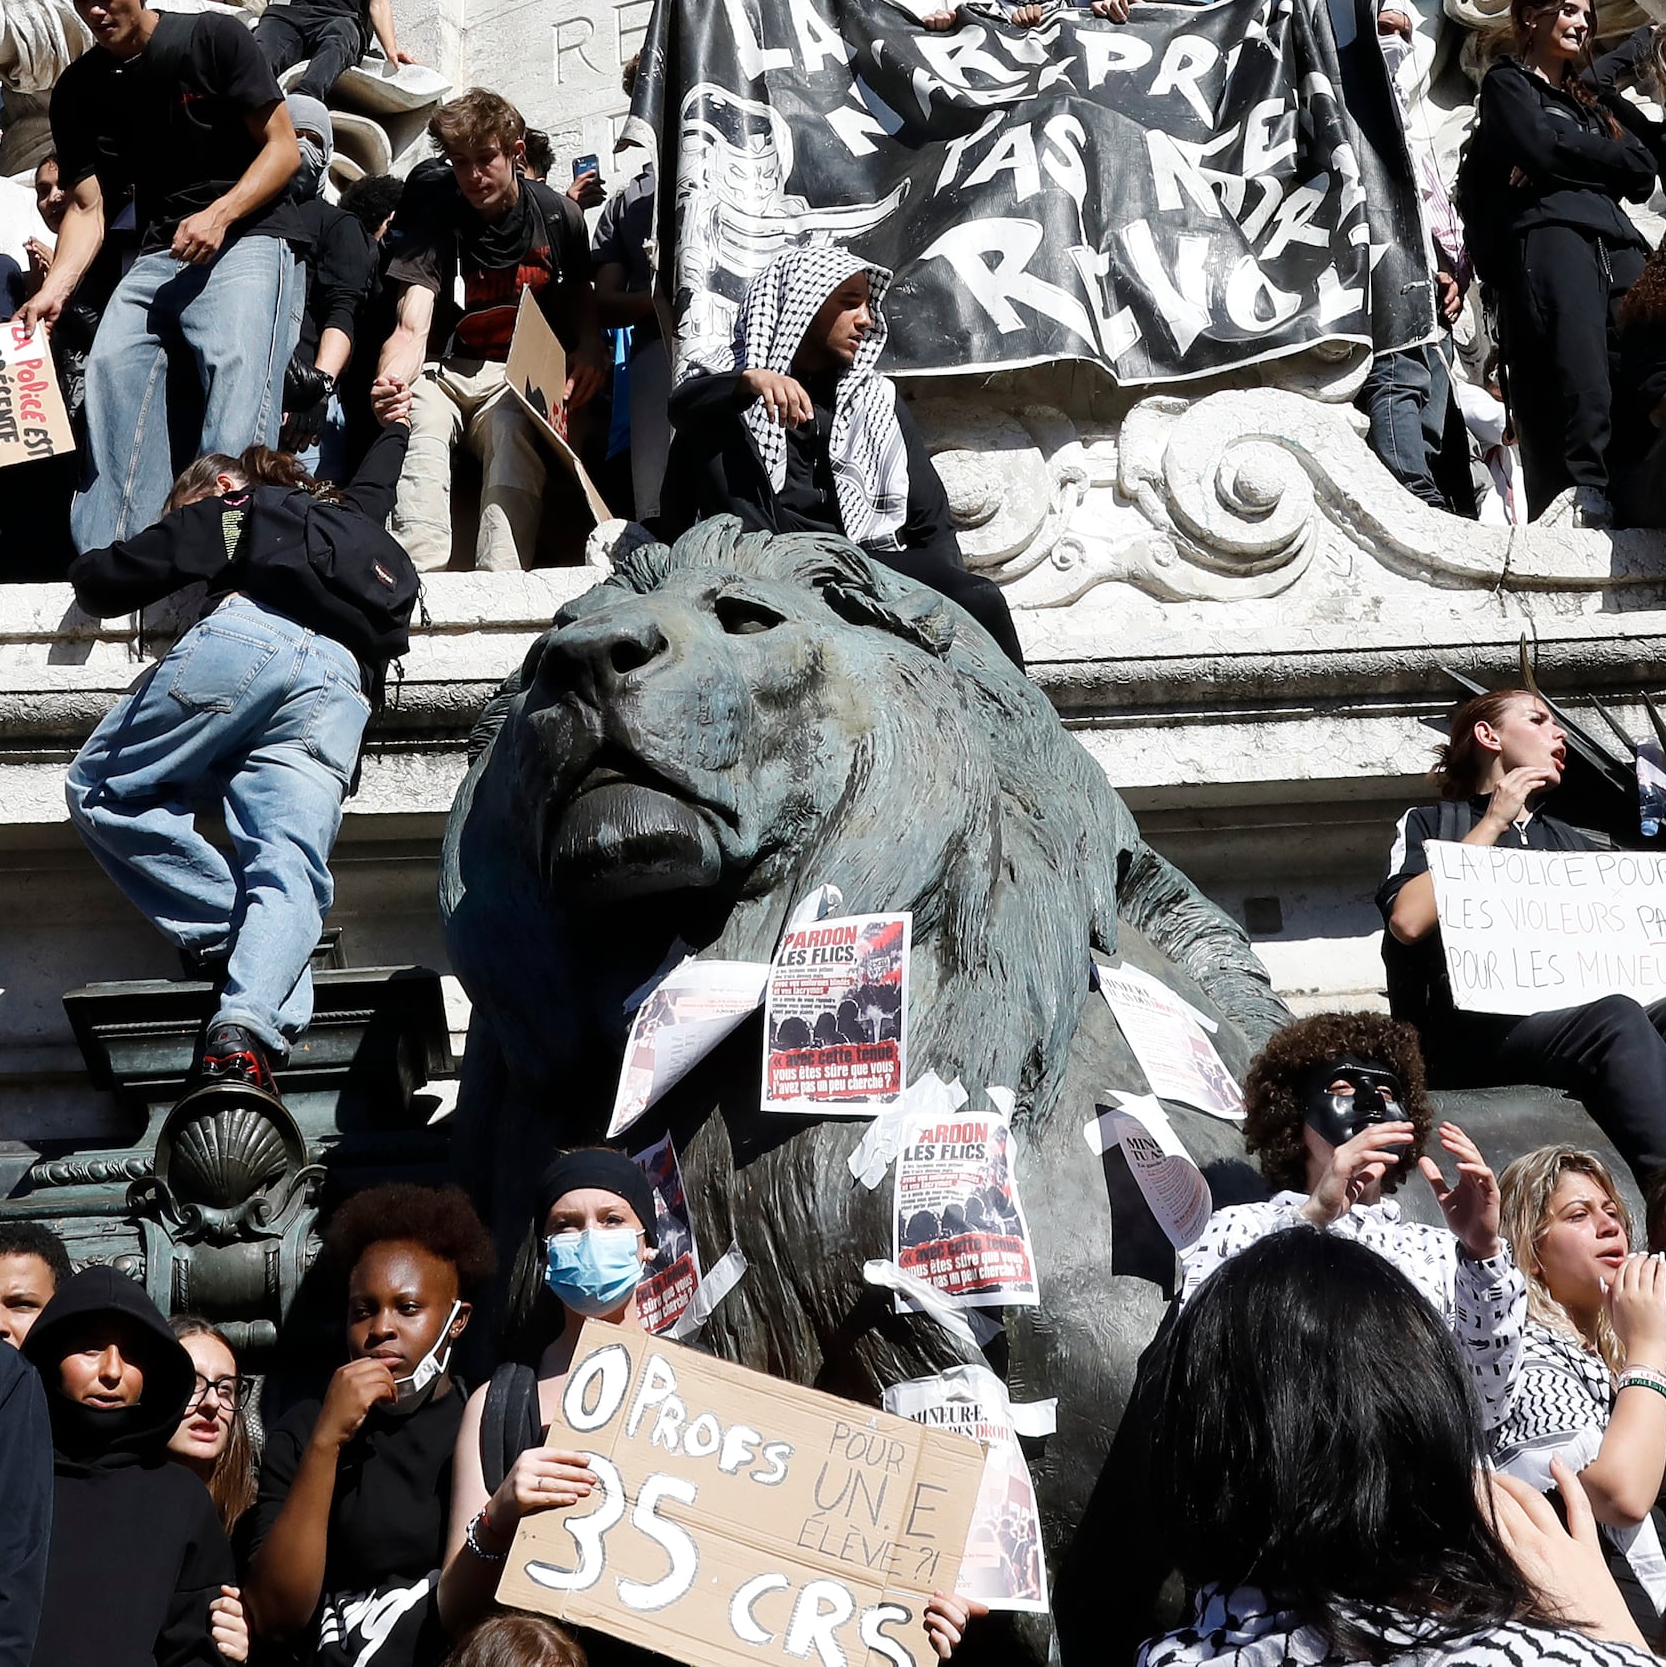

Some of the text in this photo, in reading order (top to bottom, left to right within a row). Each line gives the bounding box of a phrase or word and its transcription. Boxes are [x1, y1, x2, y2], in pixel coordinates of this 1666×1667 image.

[11, 326, 34, 351] LA
[24, 427, 54, 457] EST
[1440, 847, 1479, 882] LA
[1489, 850, 1588, 886] POLICE
[1443, 894, 1494, 930] LES
[1500, 897, 1627, 934] VIOLEURS
[777, 948, 808, 967] LES
[811, 944, 858, 966] FLICS,
[783, 925, 858, 951] PARDON
[1448, 946, 1506, 993] POUR
[1512, 947, 1566, 989] LES
[773, 1060, 895, 1081] vous êtes sûre que vous
[773, 1079, 800, 1095] l'avez
[800, 1079, 816, 1095] pas
[829, 1077, 846, 1095] peu
[848, 1073, 884, 1091] cherché
[918, 1122, 989, 1144] ARDON
[904, 1143, 989, 1164] LES FLICS,
[930, 1258, 953, 1275] êtes
[954, 1252, 979, 1270] sûre
[981, 1251, 1000, 1265] que
[625, 1352, 796, 1487] PROFS
[827, 1420, 908, 1476] POUR
[523, 1450, 916, 1667] 35 CRS
[797, 1510, 908, 1573] ÉLÈVE
